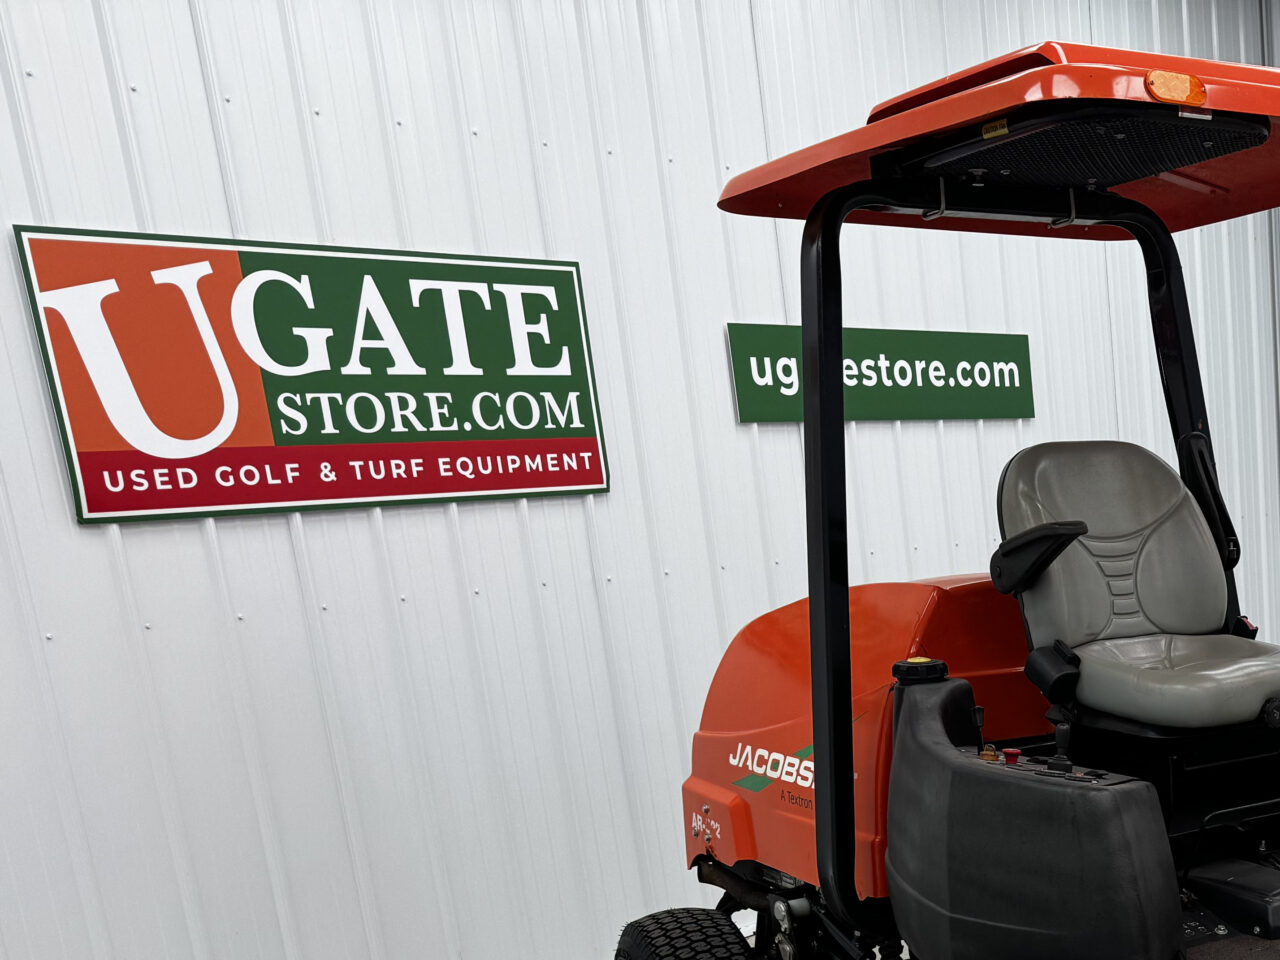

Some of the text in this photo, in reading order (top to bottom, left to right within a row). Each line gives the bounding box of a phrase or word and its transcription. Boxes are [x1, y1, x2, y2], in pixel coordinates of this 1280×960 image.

[749, 353, 1020, 396] ugestore.com
[276, 391, 585, 435] STORE.COM
[103, 452, 593, 492] USED GOLF & TURF EQUIPMENT
[729, 743, 815, 789] JACOBS
[787, 790, 813, 810] Textron
